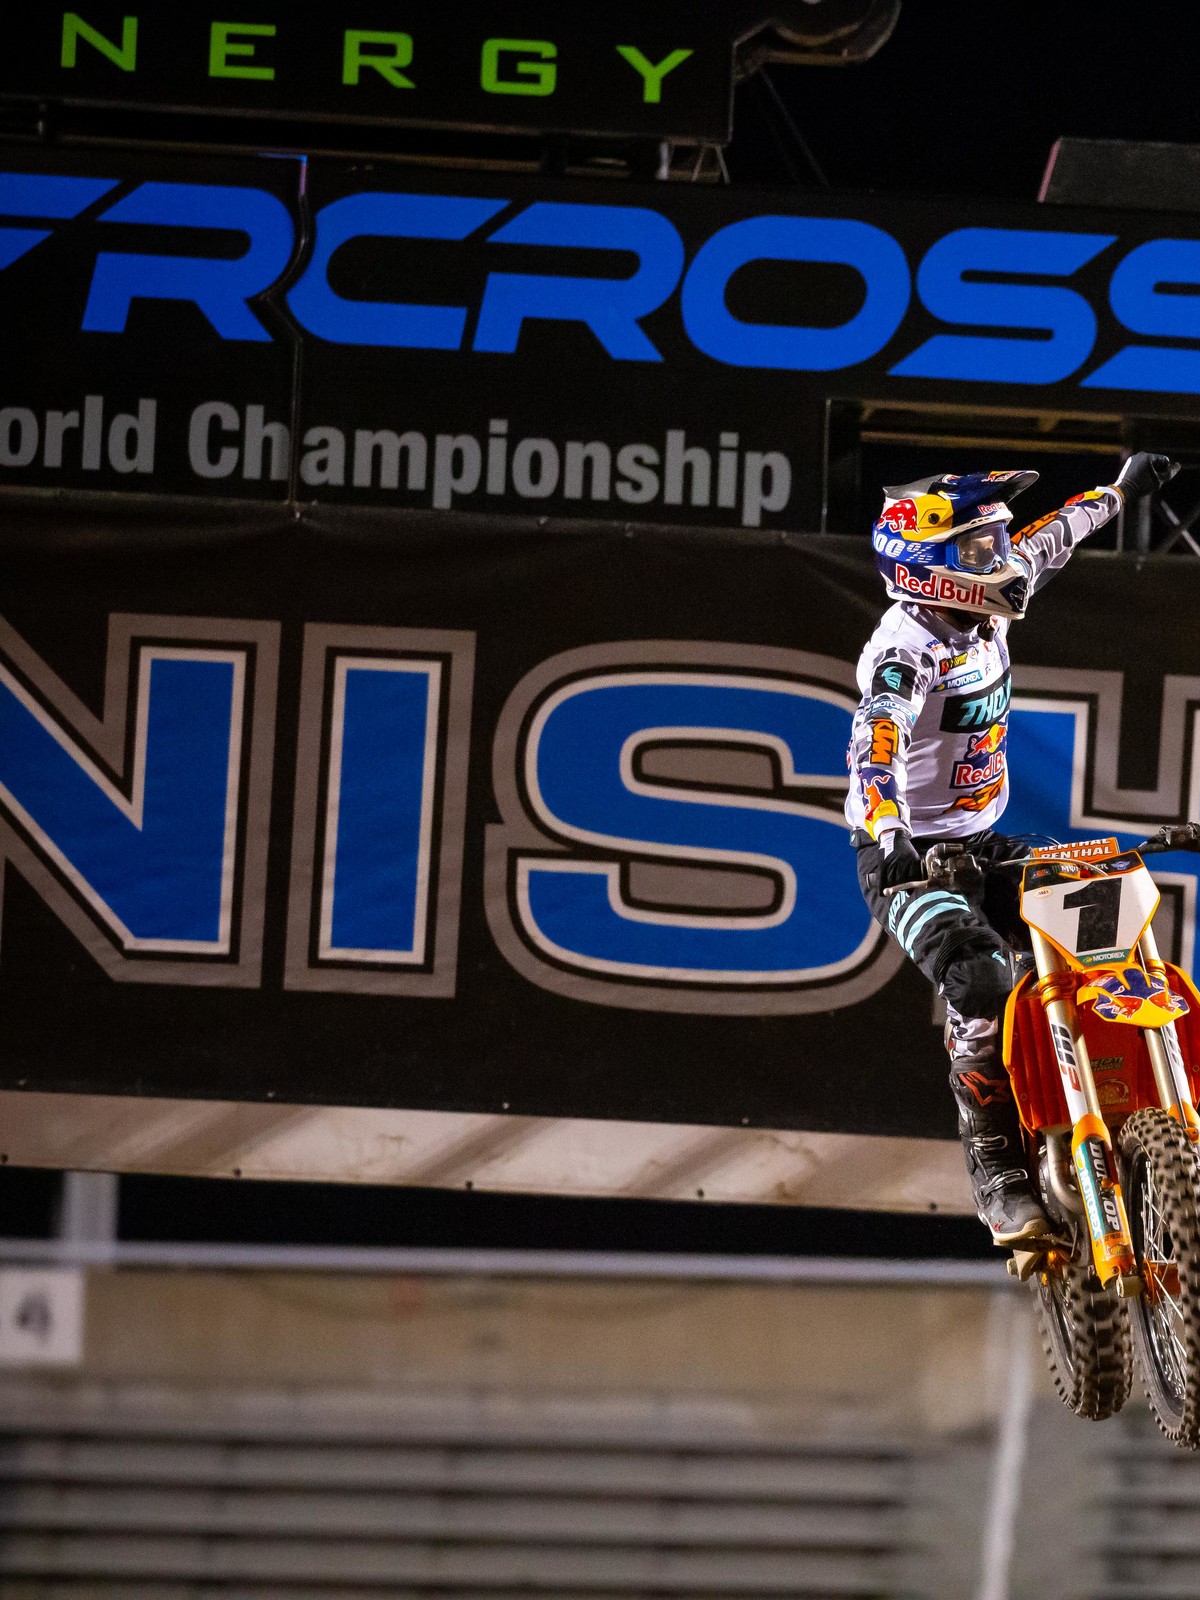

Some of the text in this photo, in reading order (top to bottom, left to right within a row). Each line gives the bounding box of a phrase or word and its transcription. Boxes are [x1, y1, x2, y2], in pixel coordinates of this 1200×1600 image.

[60, 12, 694, 104] NERGY
[188, 401, 792, 527] Championship
[896, 564, 985, 606] Red Bull
[947, 671, 981, 689] MOTOREX
[871, 700, 914, 719] MOTOREX
[870, 717, 899, 766] KTM
[955, 755, 993, 785] Red
[1041, 846, 1113, 859] RENTHAL
[1063, 877, 1122, 953] 1
[1092, 951, 1125, 961] MOTOREX
[1079, 1168, 1101, 1240] MOTOREX
